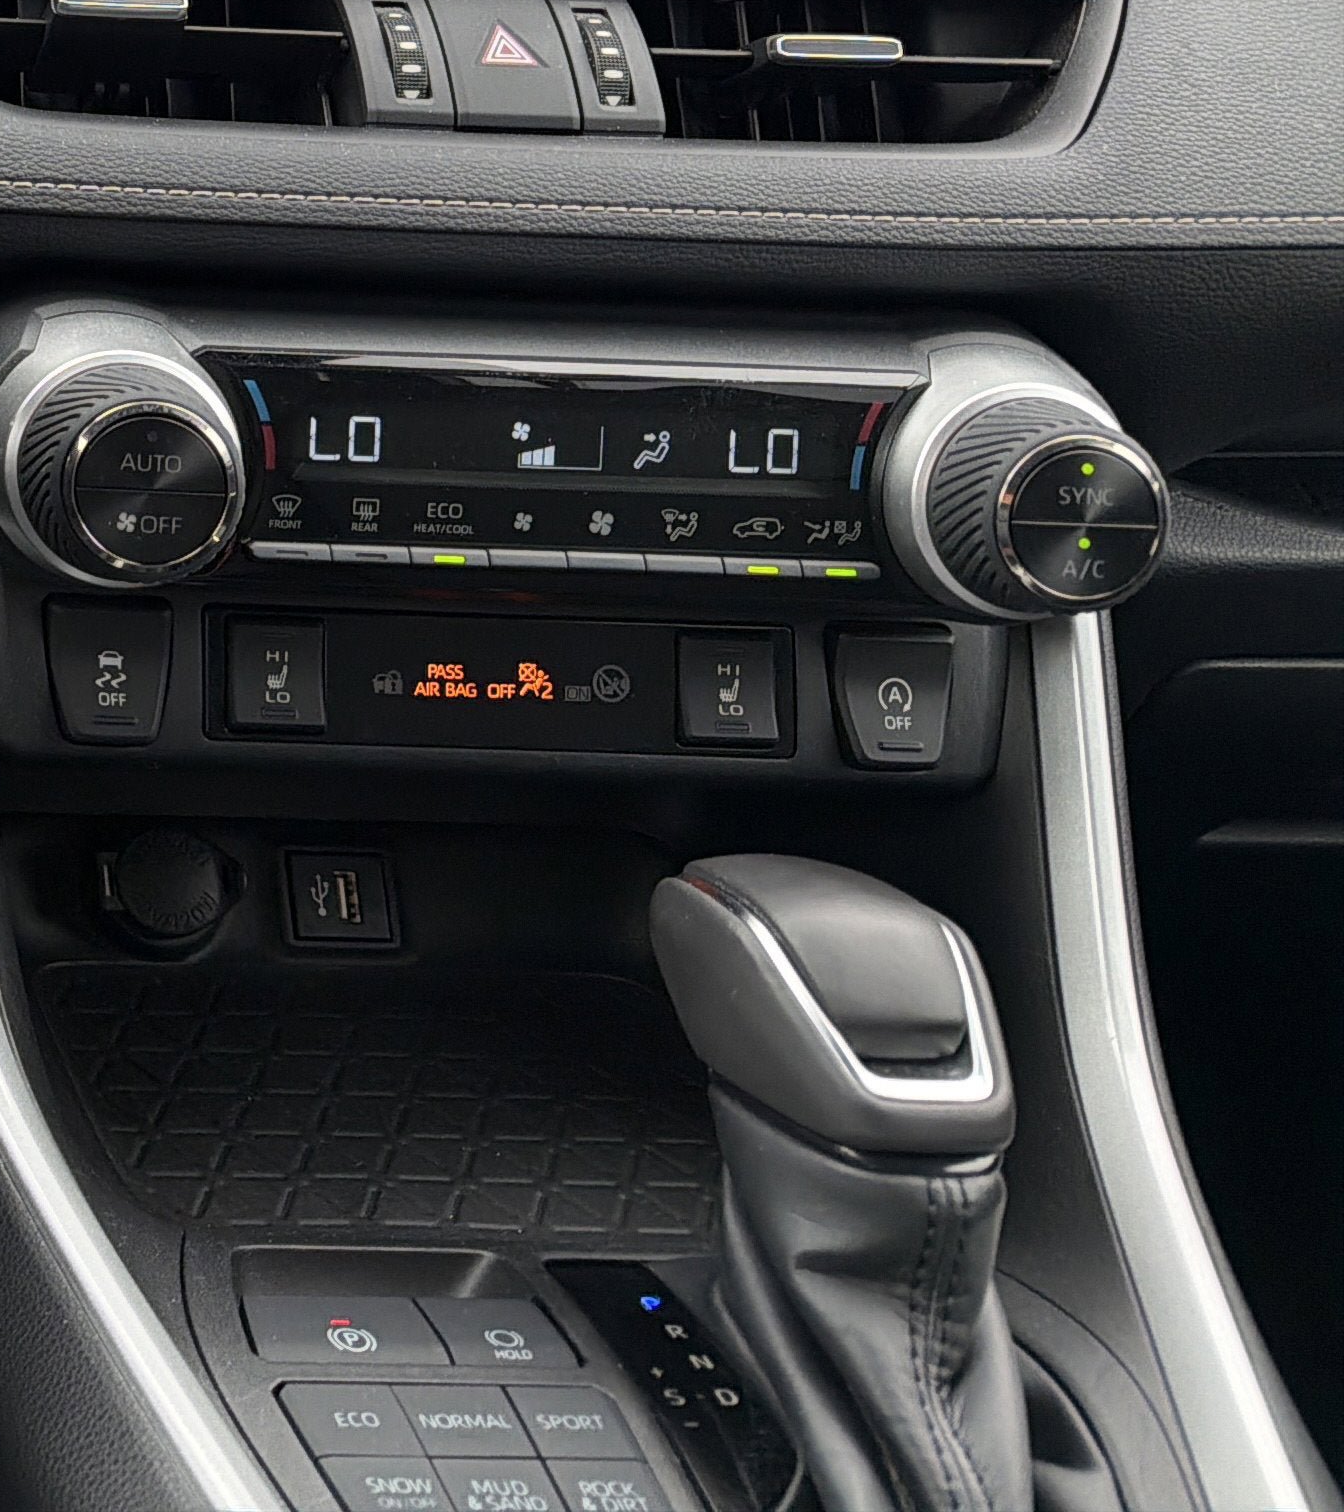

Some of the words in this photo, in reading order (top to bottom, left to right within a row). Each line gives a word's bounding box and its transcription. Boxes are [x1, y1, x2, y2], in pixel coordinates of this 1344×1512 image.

[309, 415, 383, 465] LO
[728, 428, 800, 476] LO
[120, 453, 182, 474] AUTO
[1058, 485, 1114, 508] SYNC
[427, 502, 464, 521] ECO
[141, 515, 183, 535] OFF
[268, 518, 302, 531] FRONT
[351, 521, 379, 533] REAR
[413, 523, 475, 536] HEAT/COOL
[1063, 557, 1106, 582] A/C
[265, 650, 289, 663] HI
[427, 663, 464, 680] PASS
[717, 663, 741, 678] HI
[265, 691, 291, 705] LO
[414, 682, 441, 697] AIR
[445, 683, 477, 698] BAG
[487, 683, 516, 699] OFF
[98, 691, 127, 707] OFF
[718, 704, 744, 717] LO
[884, 715, 913, 731] OFF
[640, 1296, 661, 1310] P
[664, 1324, 689, 1339] R
[494, 1349, 533, 1360] HOLD
[688, 1354, 715, 1369] N
[663, 1388, 687, 1406] S
[714, 1388, 740, 1406] D
[334, 1412, 381, 1428] ECO
[418, 1413, 512, 1430] NORMAL
[536, 1413, 604, 1431] SPORT
[365, 1477, 433, 1495] SNOW
[471, 1480, 529, 1496] MUD
[578, 1481, 639, 1498] ROCK
[487, 1496, 548, 1511] SAND
[601, 1496, 648, 1512] DIRT
